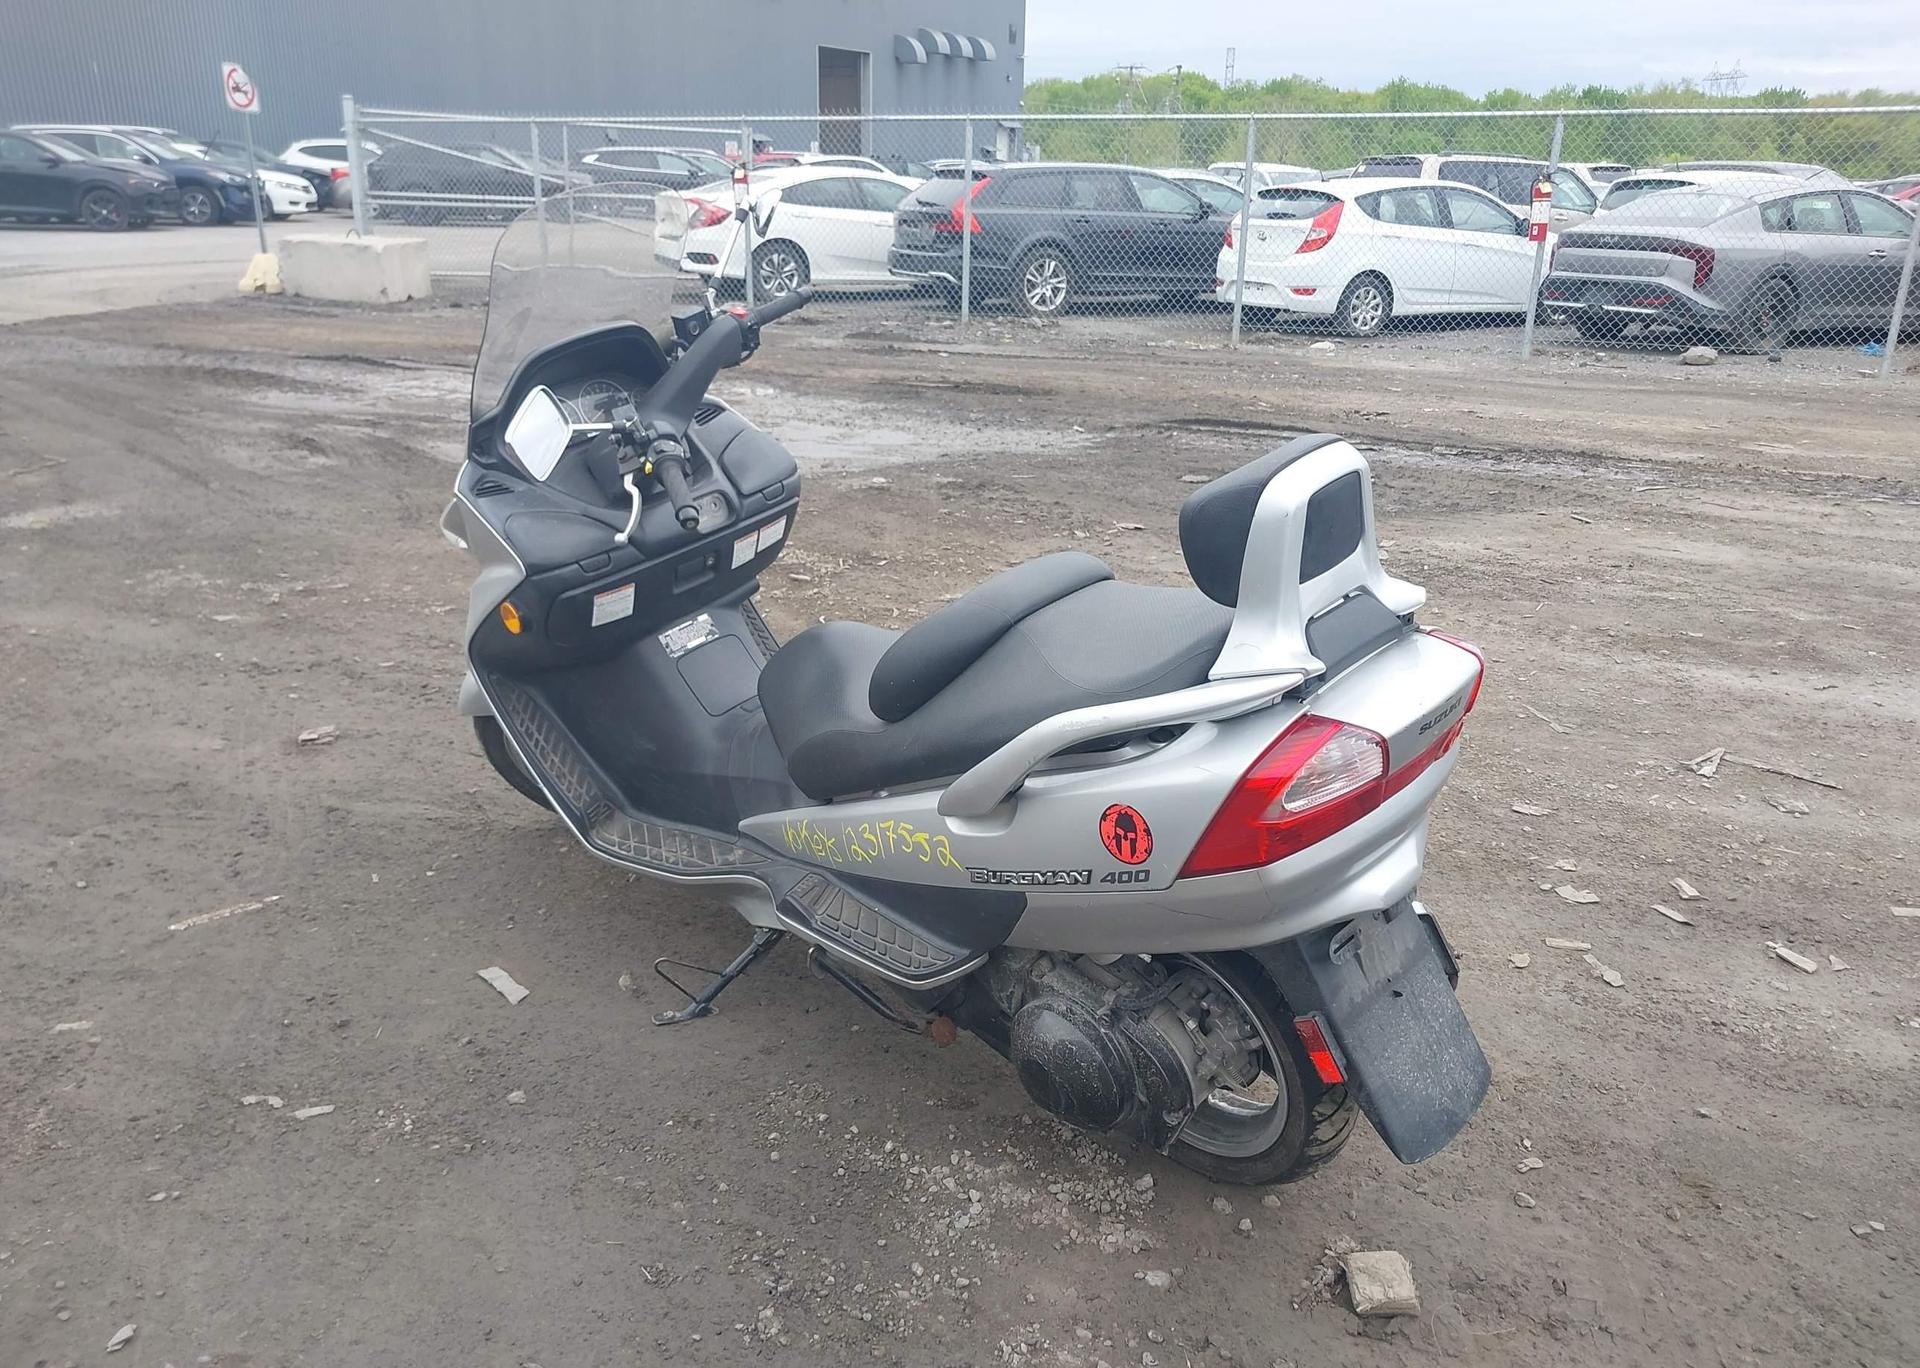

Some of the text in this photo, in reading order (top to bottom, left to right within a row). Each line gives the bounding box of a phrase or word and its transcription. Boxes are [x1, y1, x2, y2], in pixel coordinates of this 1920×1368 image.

[1418, 695, 1463, 735] SUZUKI
[965, 867, 1150, 885] BURGMAN 400
